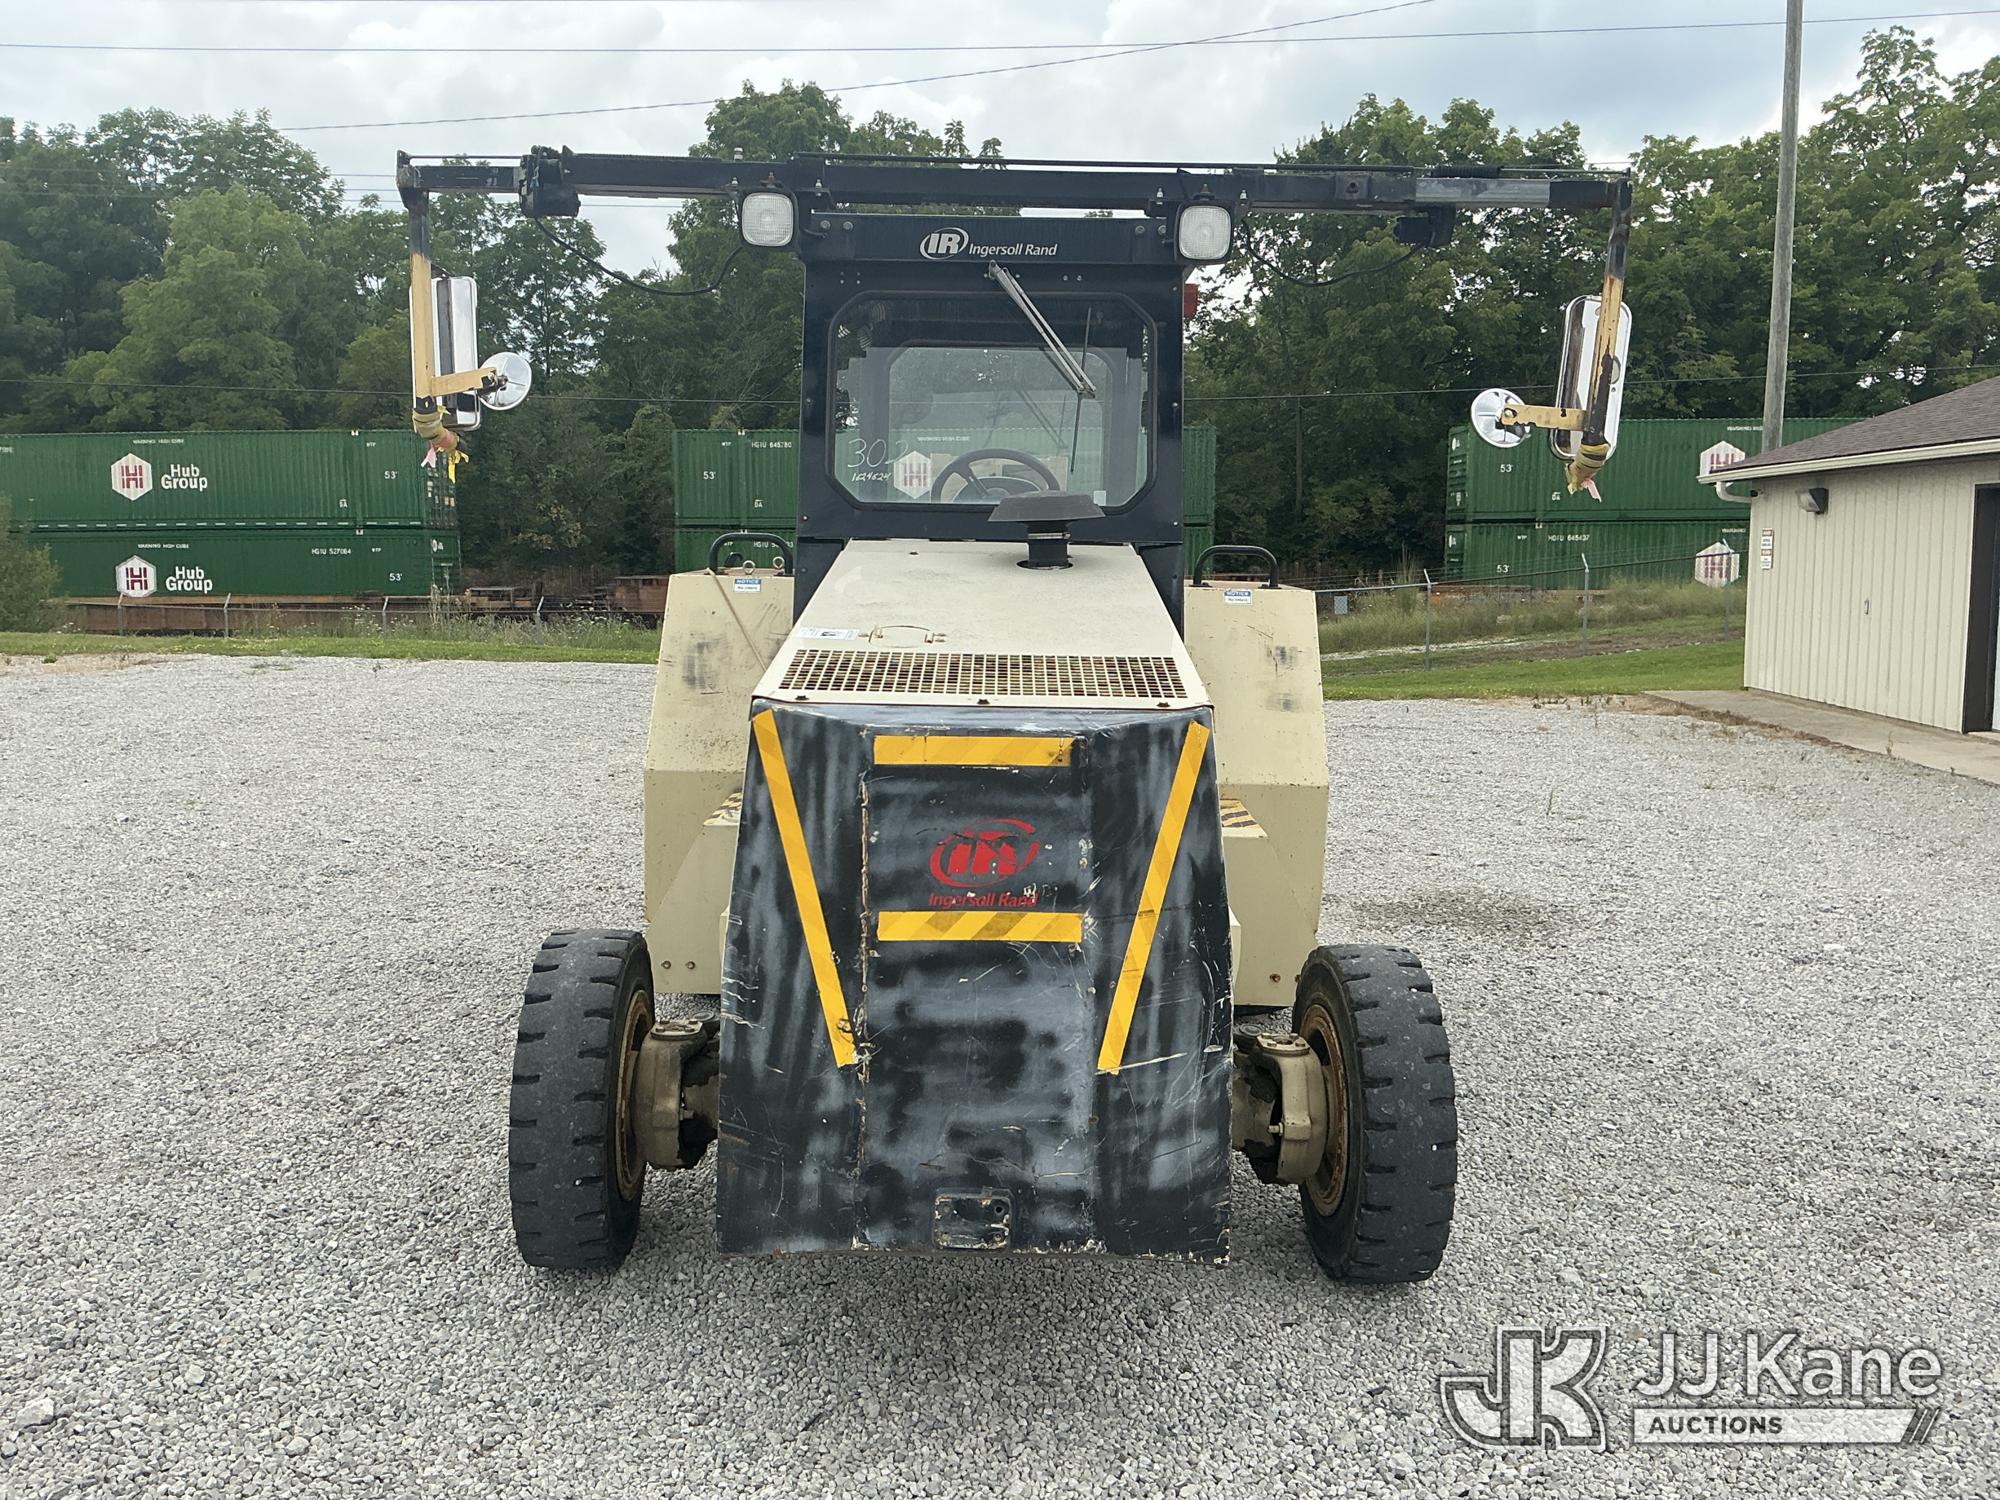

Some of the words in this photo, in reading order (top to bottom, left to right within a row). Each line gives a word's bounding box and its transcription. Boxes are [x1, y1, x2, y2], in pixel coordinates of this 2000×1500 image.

[927, 233, 961, 254] IR
[968, 243, 1022, 258] Ingersoll
[1025, 243, 1058, 256] Rand
[170, 463, 200, 477] Hub
[161, 474, 208, 492] Group
[175, 565, 205, 579] Hub
[165, 576, 213, 594] Group
[928, 892, 995, 909] Ingersoll
[998, 892, 1040, 908] Rand
